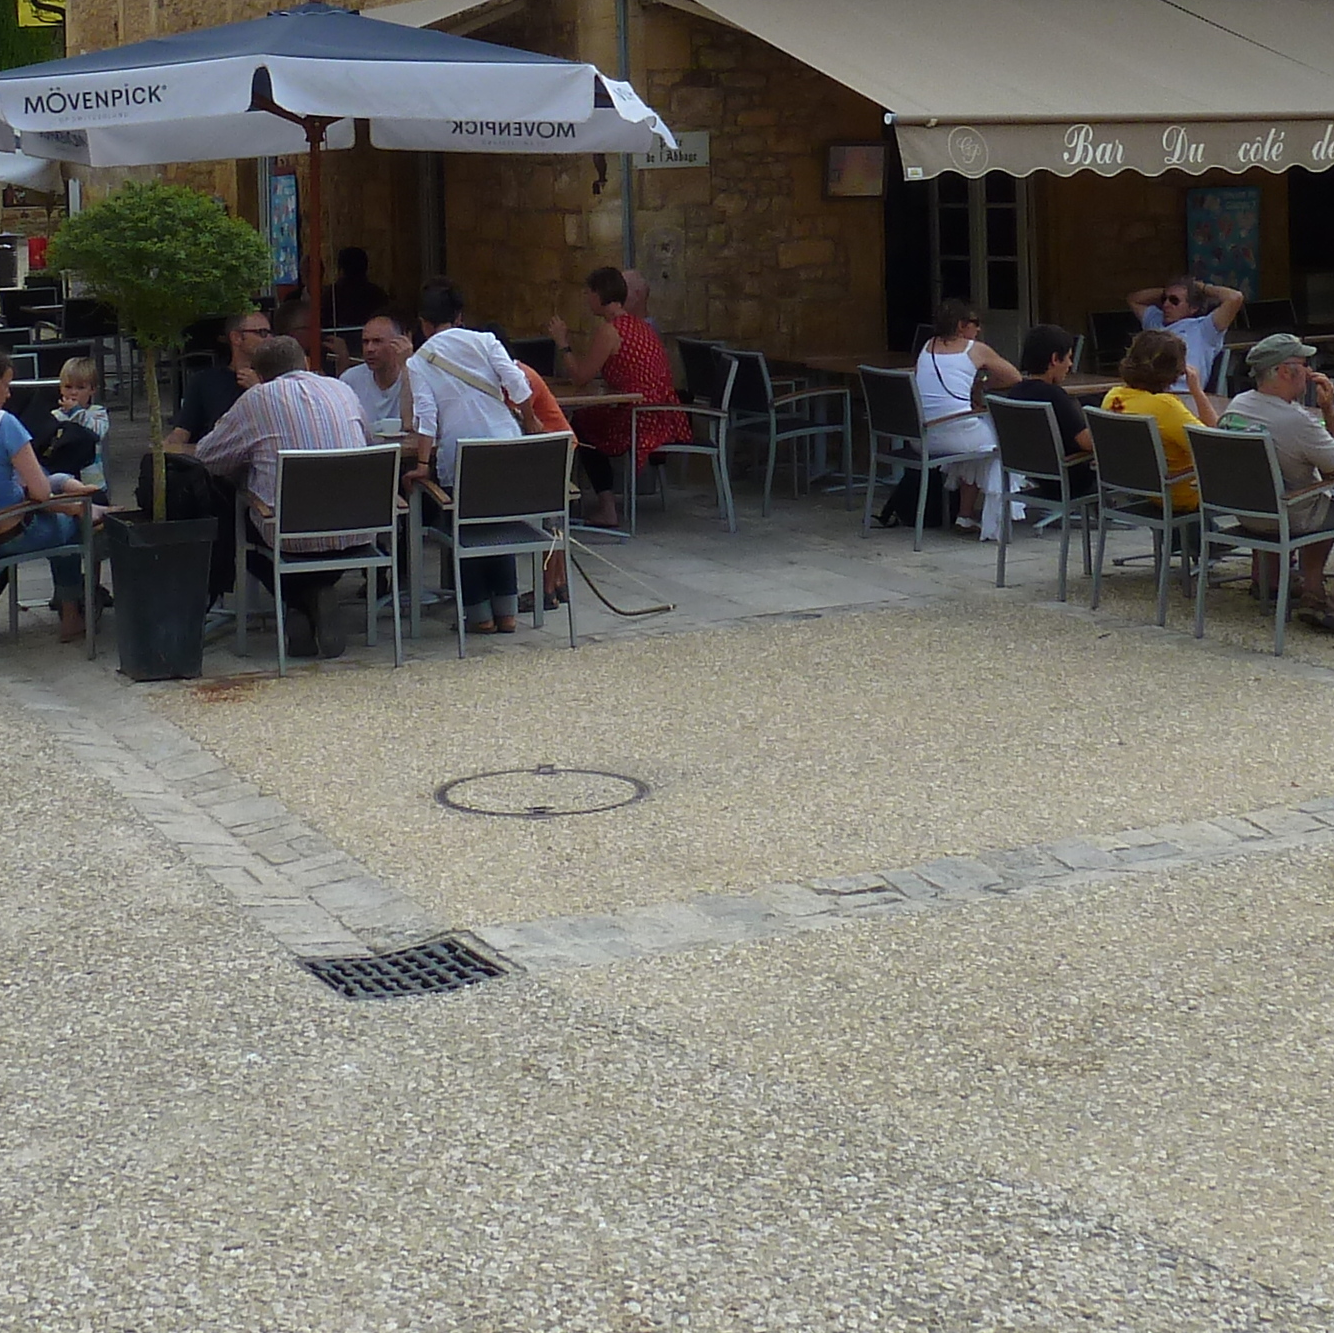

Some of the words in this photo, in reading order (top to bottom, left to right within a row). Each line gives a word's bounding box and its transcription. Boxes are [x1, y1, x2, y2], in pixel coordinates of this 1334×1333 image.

[24, 83, 163, 114] MÖVENPICK
[1063, 123, 1125, 165] Bar
[1162, 125, 1205, 164] Du
[1237, 127, 1285, 163] côté
